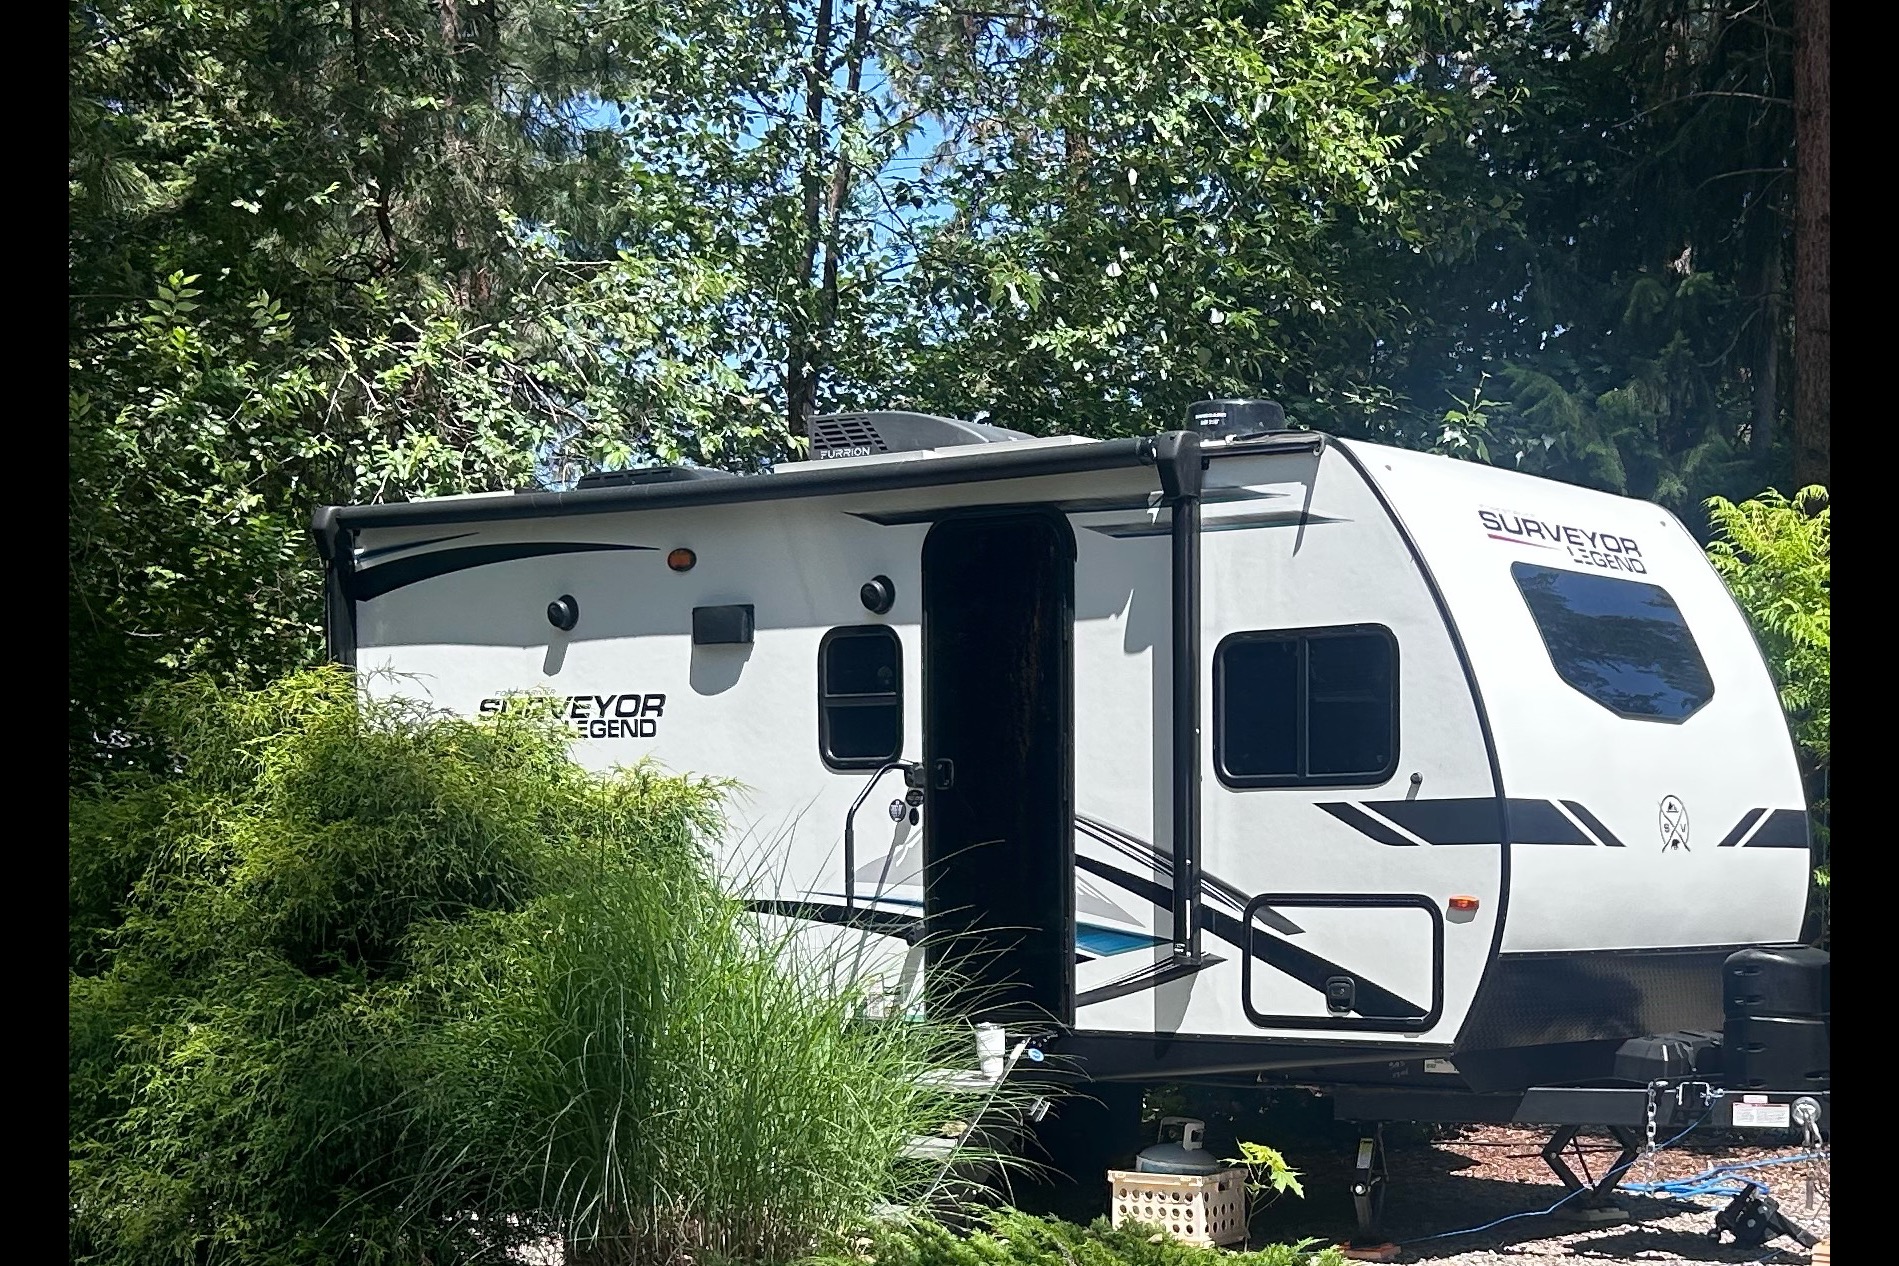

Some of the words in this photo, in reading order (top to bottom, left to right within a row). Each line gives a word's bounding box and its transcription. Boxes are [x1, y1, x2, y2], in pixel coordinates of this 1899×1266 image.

[820, 447, 870, 459] FURRION
[1478, 510, 1642, 557] SURVEYOR
[1566, 546, 1647, 574] LEGEND
[566, 719, 657, 738] EGEND
